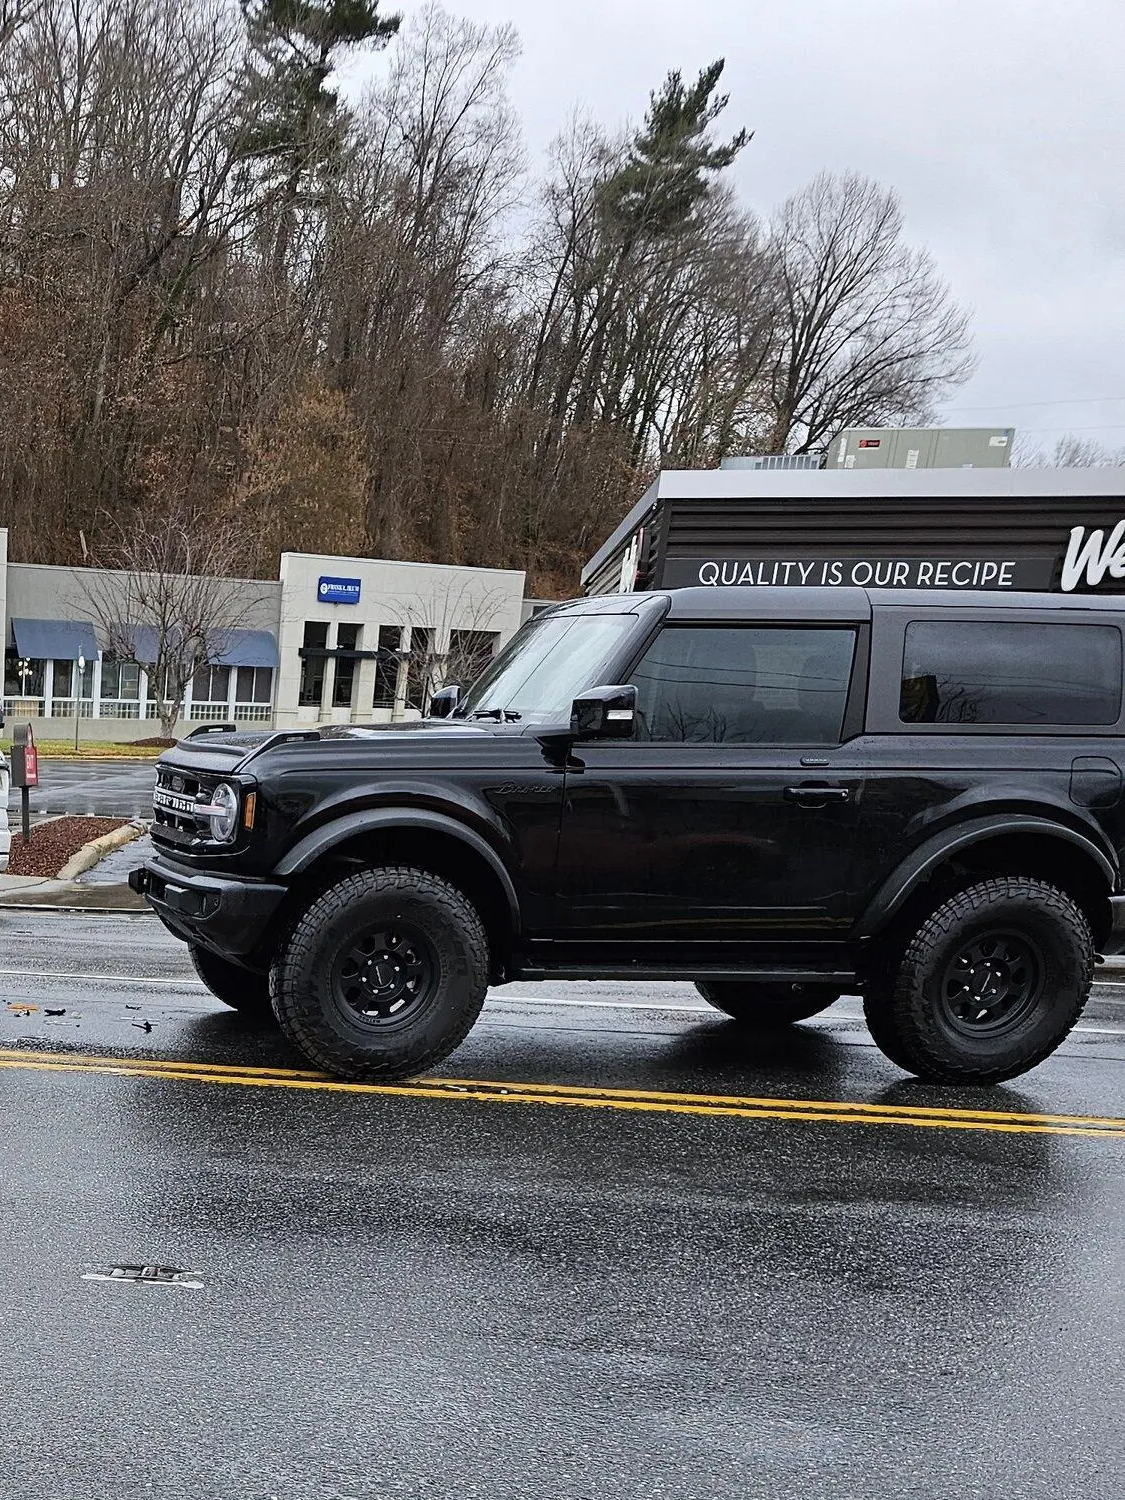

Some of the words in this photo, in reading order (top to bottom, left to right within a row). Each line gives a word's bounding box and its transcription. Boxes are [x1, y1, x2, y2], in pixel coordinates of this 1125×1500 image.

[698, 561, 816, 588] QUALITY
[820, 561, 845, 587] IS
[851, 561, 909, 587] OUR
[916, 561, 1017, 587] RECIPE
